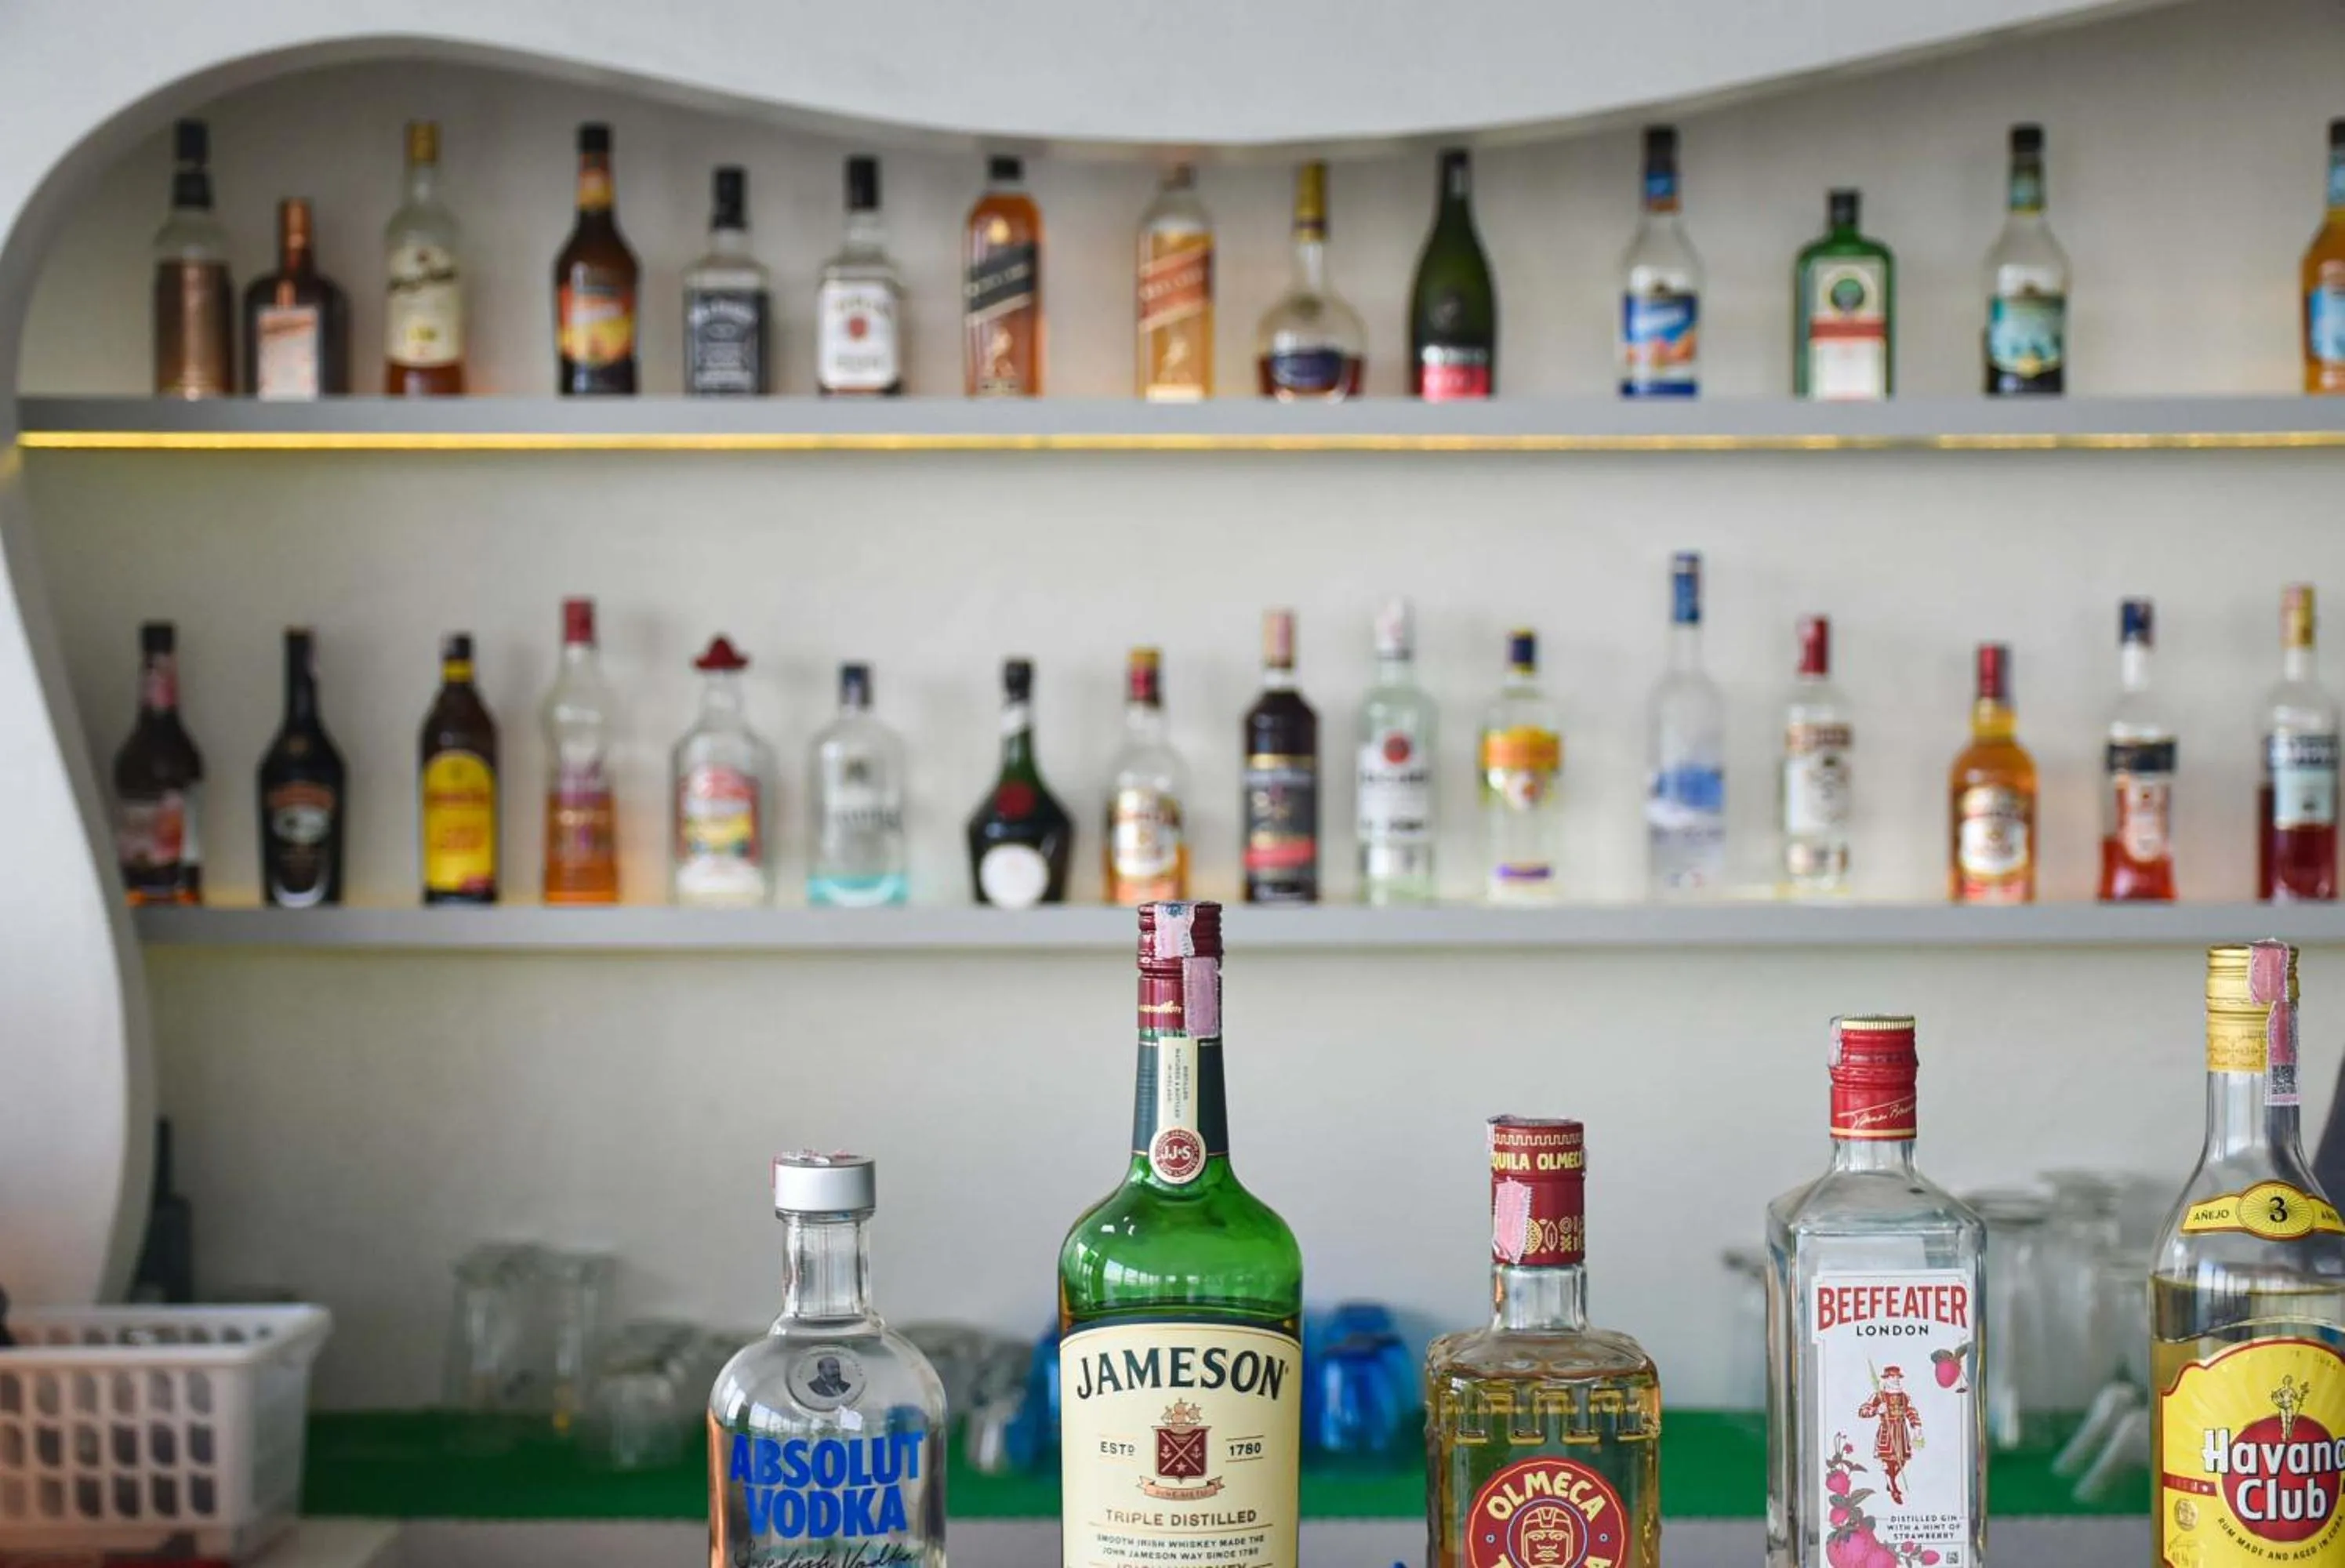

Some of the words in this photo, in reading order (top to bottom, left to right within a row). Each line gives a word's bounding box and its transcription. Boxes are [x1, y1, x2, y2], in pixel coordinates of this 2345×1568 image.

[1536, 1150, 1583, 1171] OLMEC
[2193, 1208, 2230, 1222] AÑEJO
[2268, 1196, 2289, 1224] 3
[1817, 1284, 1969, 1331] BEEFEATER
[1856, 1324, 1929, 1337] LONDON
[1076, 1346, 1284, 1401] JAMESON
[729, 1430, 925, 1489] ABSOLUT
[1229, 1441, 1262, 1457] 1780
[1486, 1470, 1606, 1523] OLMECA
[2236, 1475, 2328, 1522] Club
[745, 1484, 908, 1539] VODKA
[1105, 1508, 1164, 1526] TRIPLE
[1170, 1509, 1258, 1527] DISTILLED
[1097, 1534, 1134, 1545] SMOOTH
[1137, 1539, 1165, 1548] IRISH
[1168, 1540, 1217, 1548] WHISKEY
[1218, 1537, 1247, 1548] MADE
[1248, 1534, 1265, 1544] THE
[2217, 1516, 2237, 1537] RUM
[2236, 1537, 2264, 1556] MADE
[2267, 1550, 2289, 1561] AND
[2292, 1546, 2318, 1561] AGED
[2318, 1538, 2329, 1549] IN
[843, 1540, 913, 1568] Vodka
[1102, 1547, 1126, 1556] JOHN
[1128, 1550, 1177, 1559] JAMESON
[1179, 1552, 1202, 1560] WAY
[1206, 1549, 1236, 1559] SINCE
